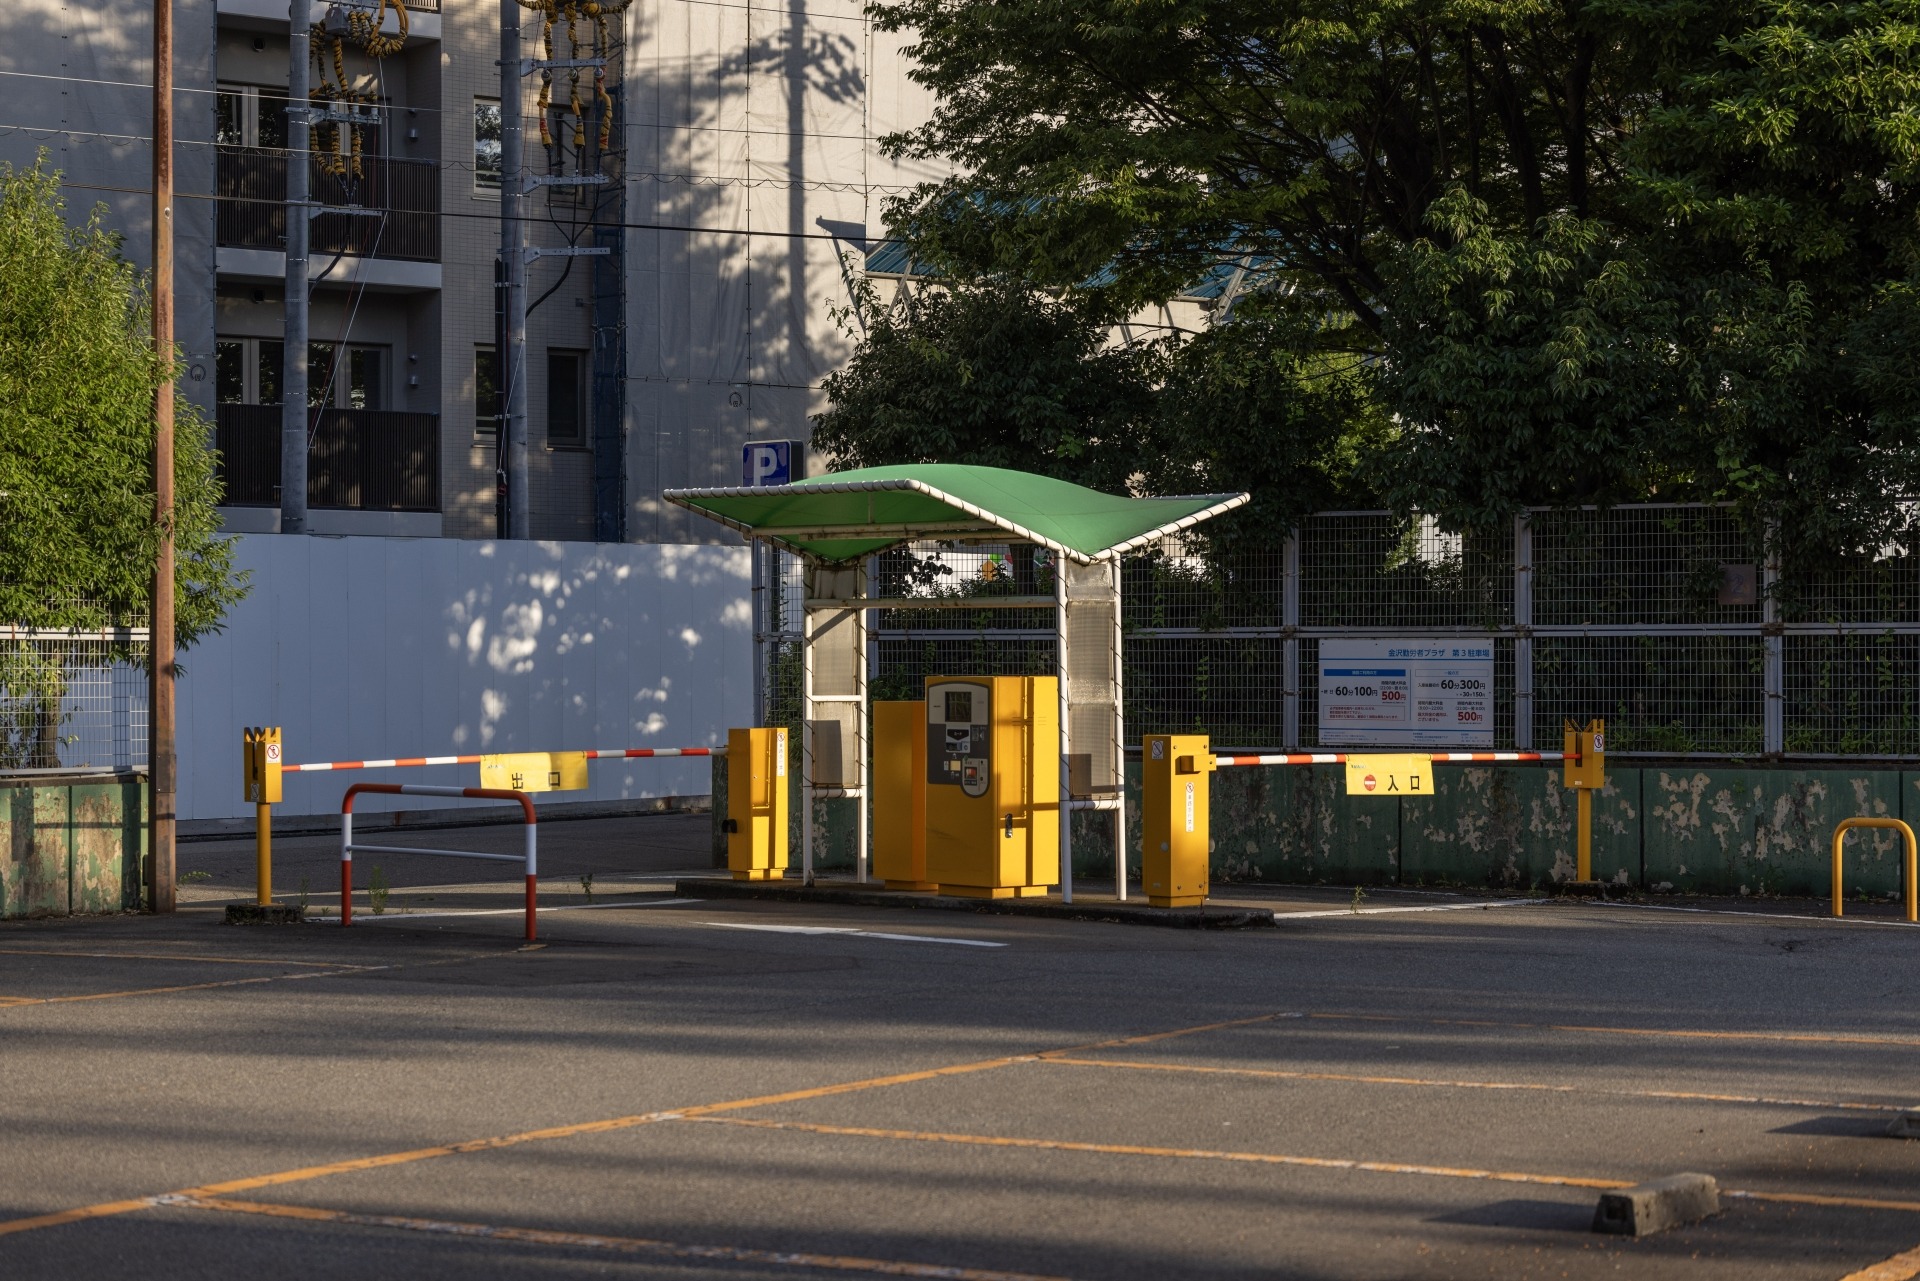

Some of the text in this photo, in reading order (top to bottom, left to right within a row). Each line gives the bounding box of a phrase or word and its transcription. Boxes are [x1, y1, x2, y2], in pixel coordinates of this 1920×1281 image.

[753, 447, 777, 487] P
[1388, 648, 1445, 658] 金沢勤労者プラザ
[1381, 691, 1407, 701] 500円
[1457, 711, 1483, 722] 500円
[1387, 774, 1420, 792] 入口
